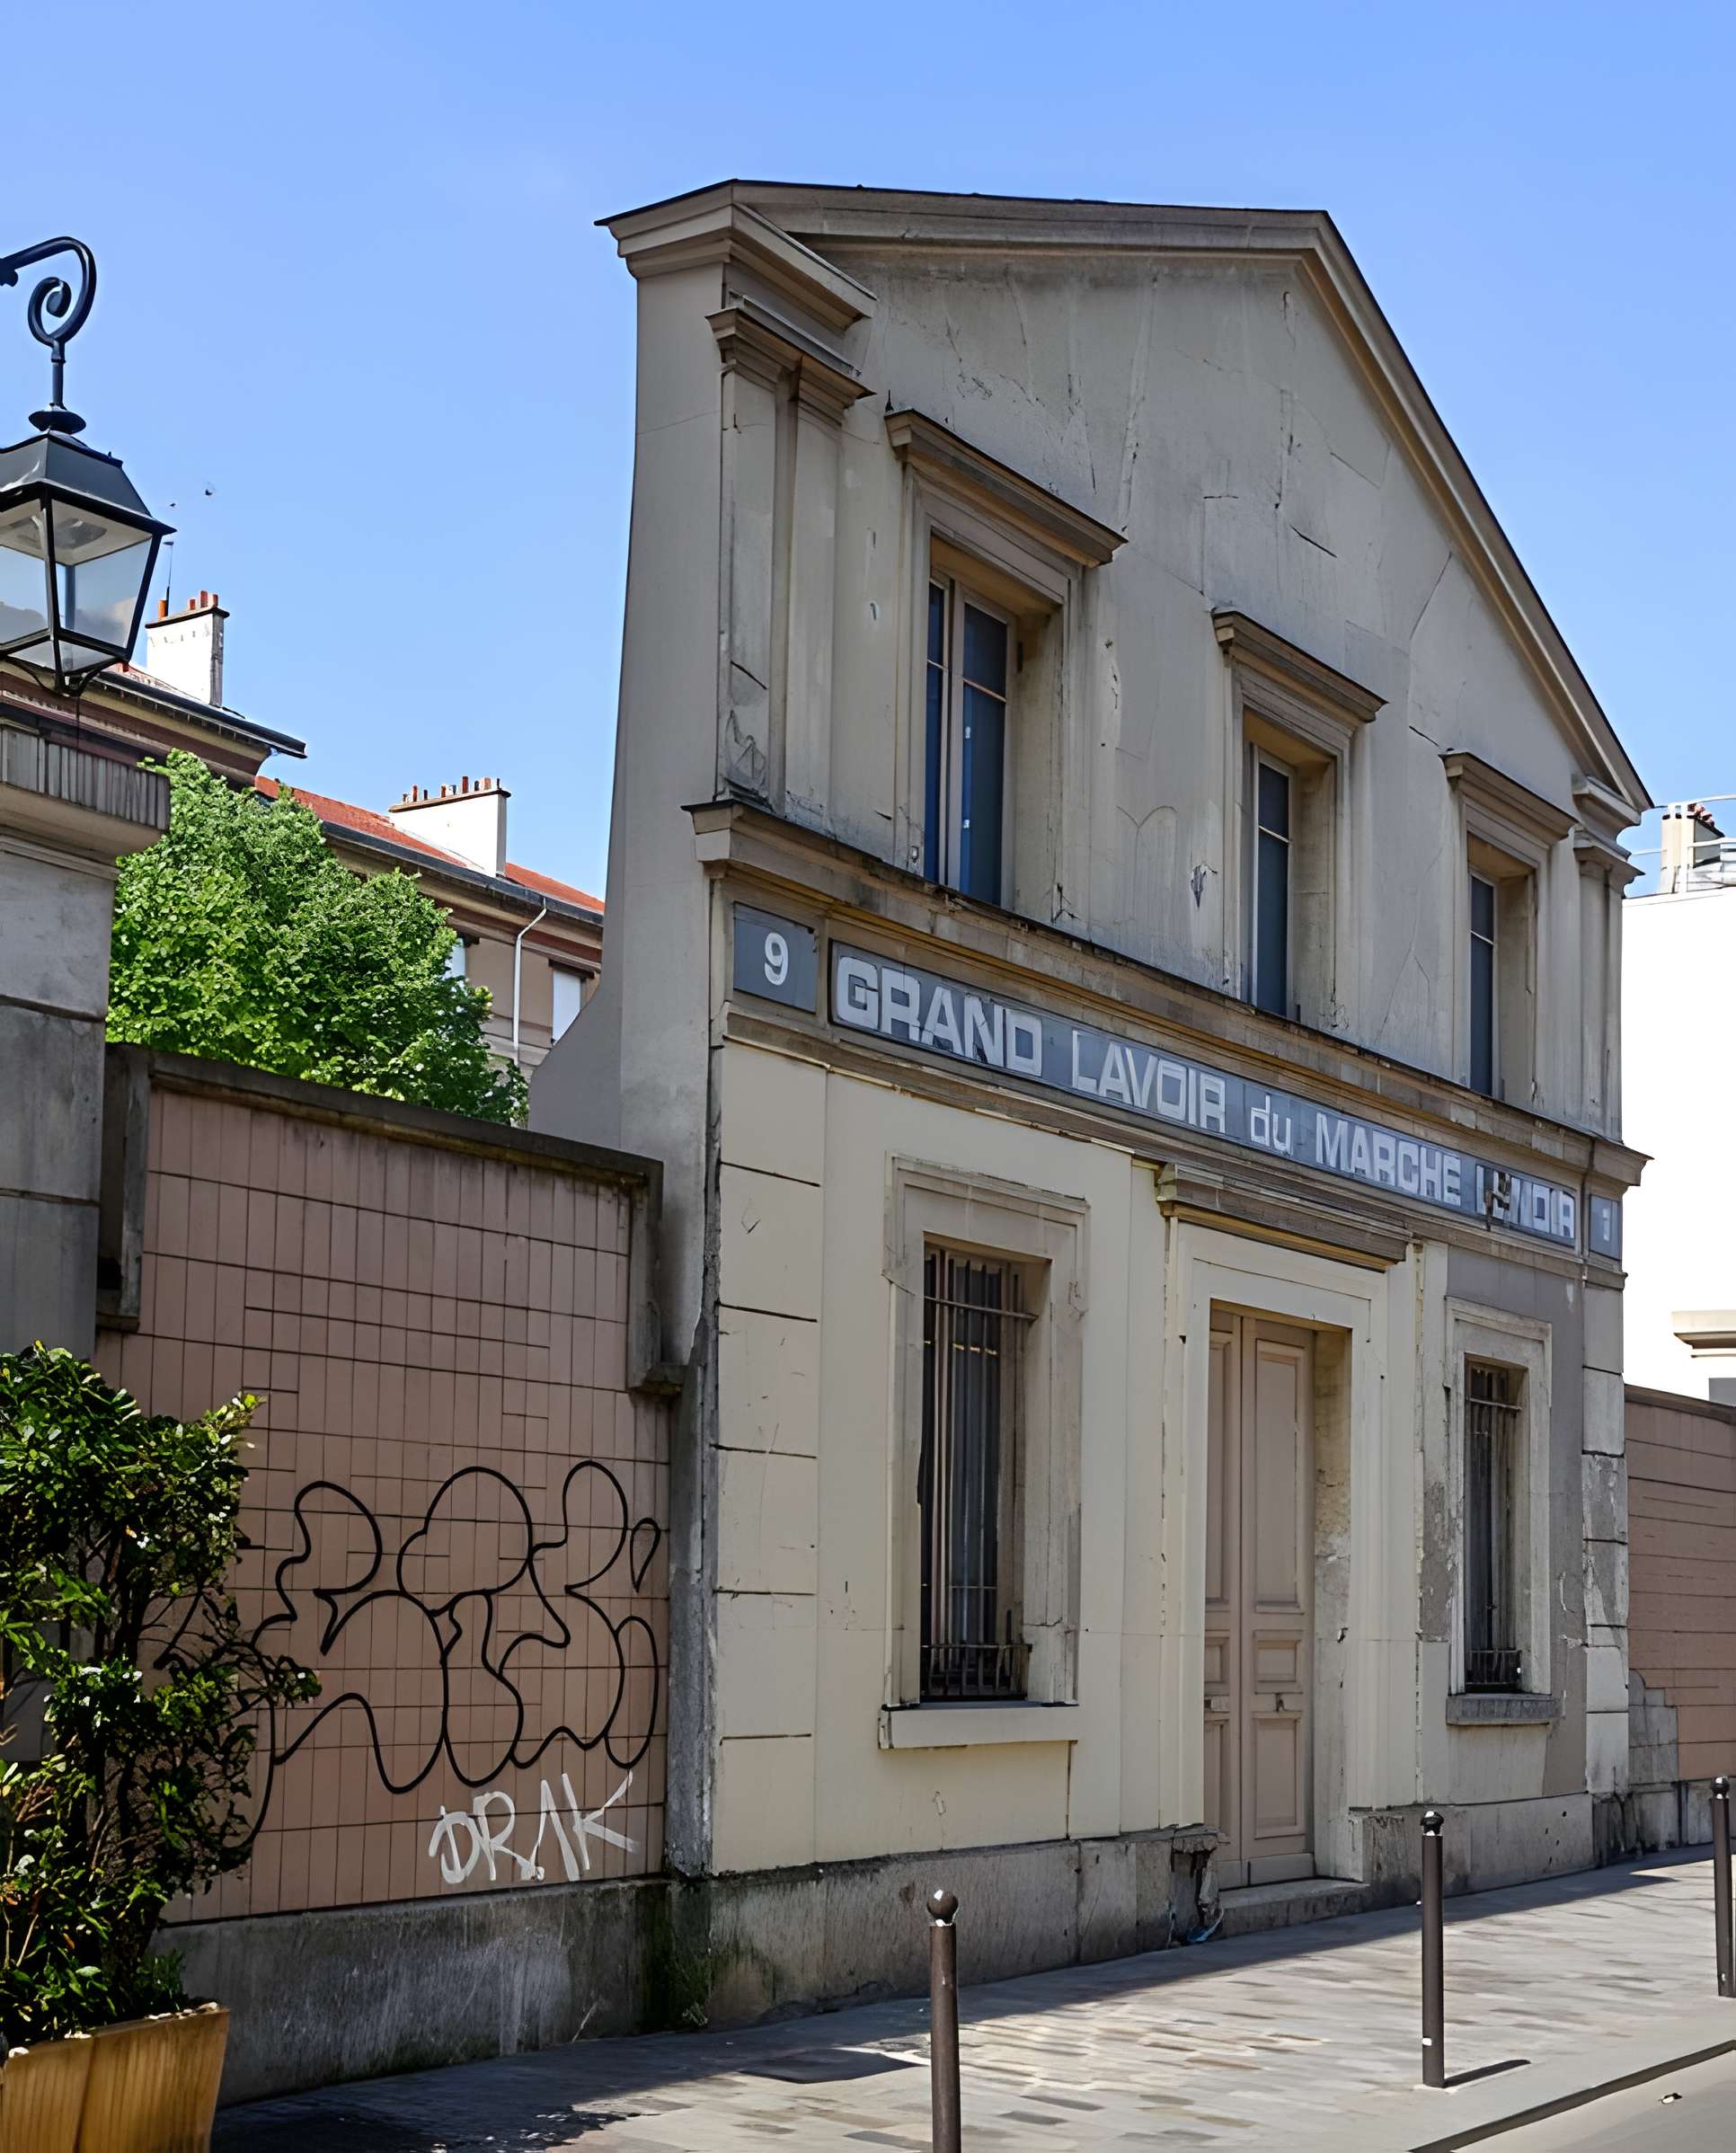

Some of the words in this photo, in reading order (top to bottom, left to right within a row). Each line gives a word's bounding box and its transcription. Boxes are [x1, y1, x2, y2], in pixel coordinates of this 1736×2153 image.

[764, 932, 789, 986] 9
[836, 956, 1042, 1076] GRAND
[1072, 1030, 1227, 1134] LAVOIR
[1250, 1094, 1293, 1156] du
[1315, 1112, 1462, 1207] MARCHE
